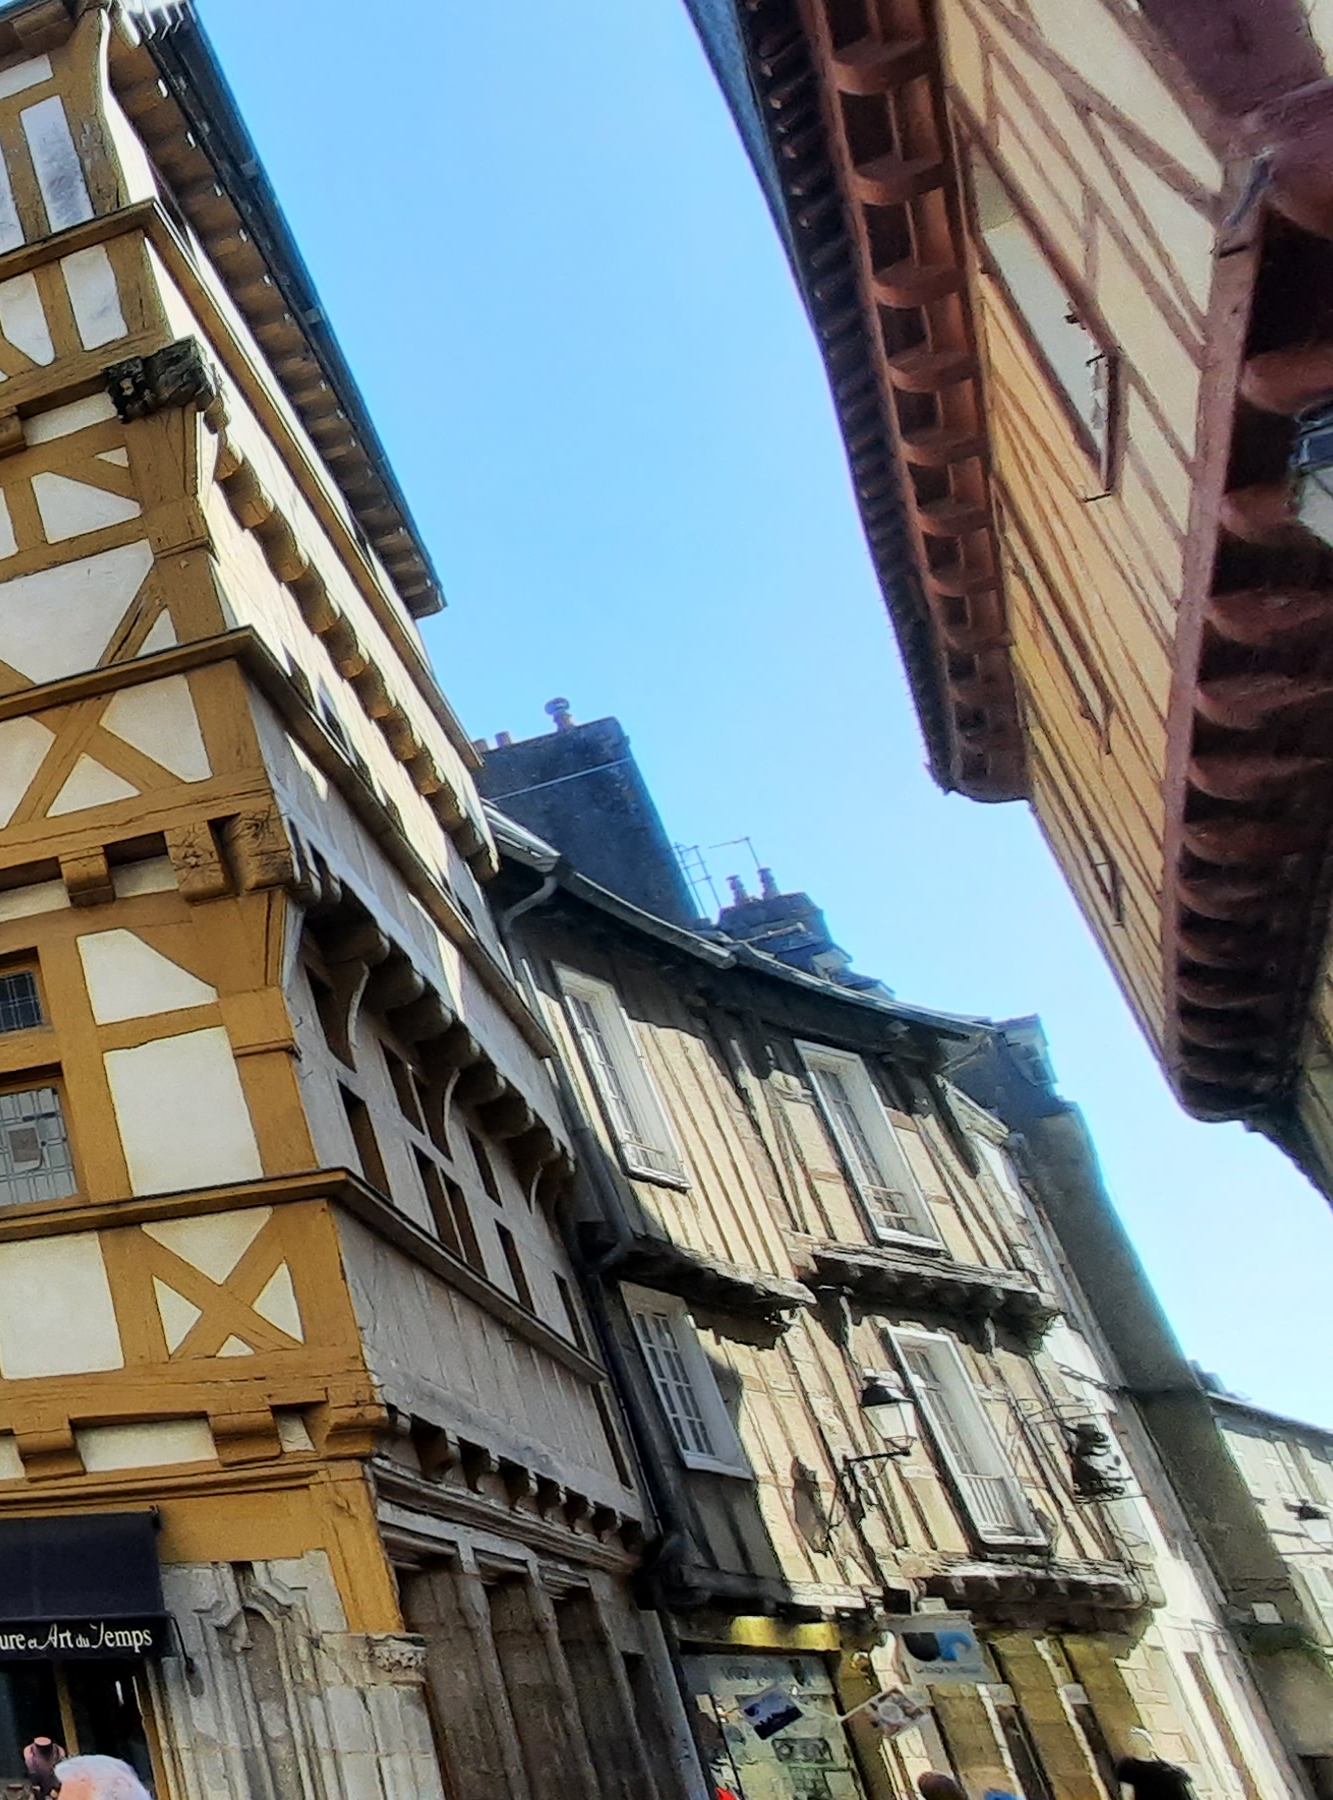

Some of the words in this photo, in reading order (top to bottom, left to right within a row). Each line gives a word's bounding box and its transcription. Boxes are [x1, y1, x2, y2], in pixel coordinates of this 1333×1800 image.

[36, 1623, 74, 1650] Art
[75, 1634, 90, 1649] du
[90, 1622, 153, 1653] Temps
